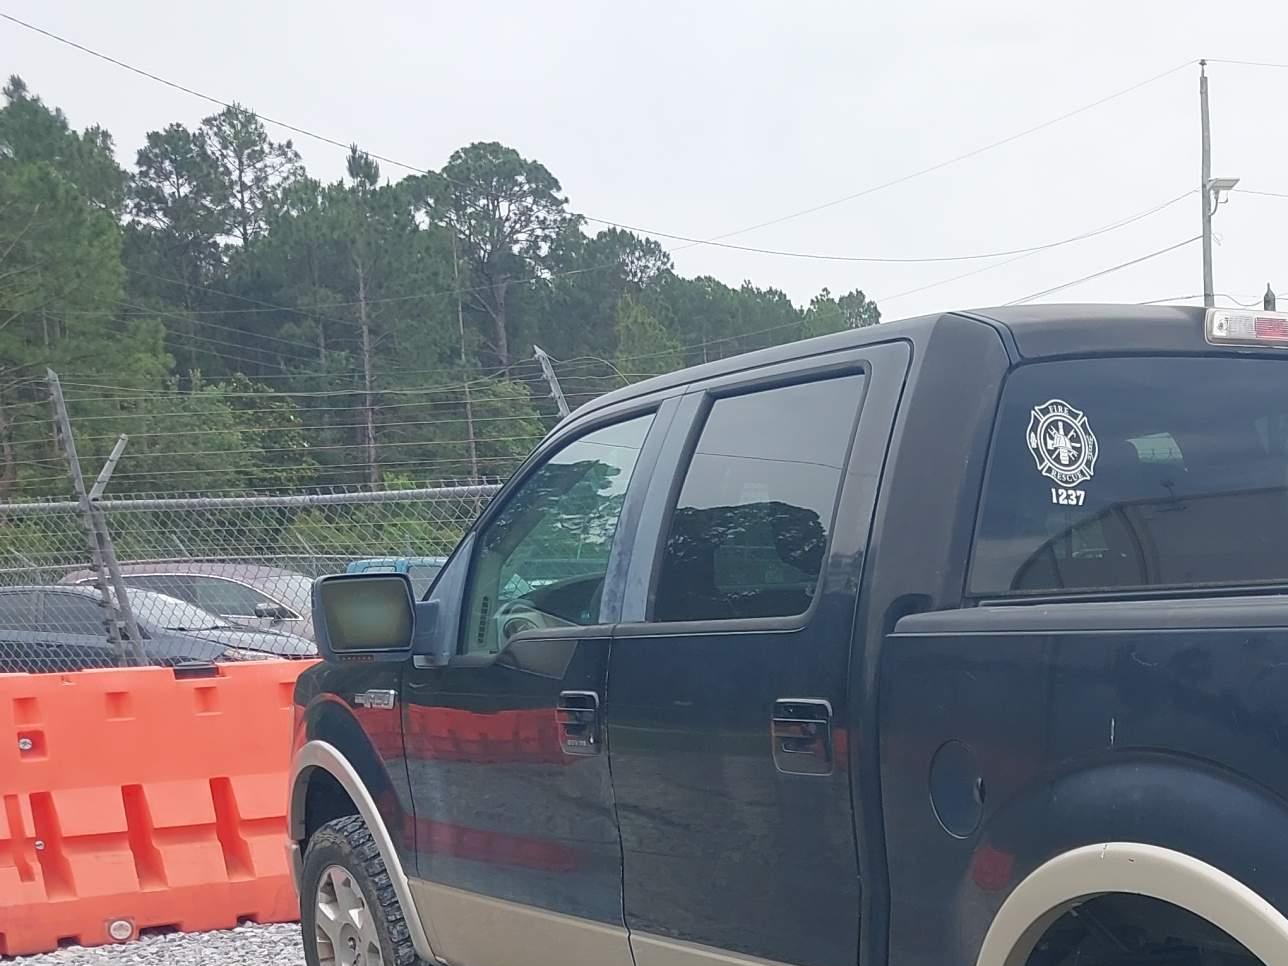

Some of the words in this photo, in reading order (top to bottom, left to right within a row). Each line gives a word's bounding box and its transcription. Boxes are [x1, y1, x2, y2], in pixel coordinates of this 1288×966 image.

[1048, 405, 1070, 416] FIRE
[1051, 470, 1083, 482] RESCUE
[1051, 488, 1085, 505] 1237
